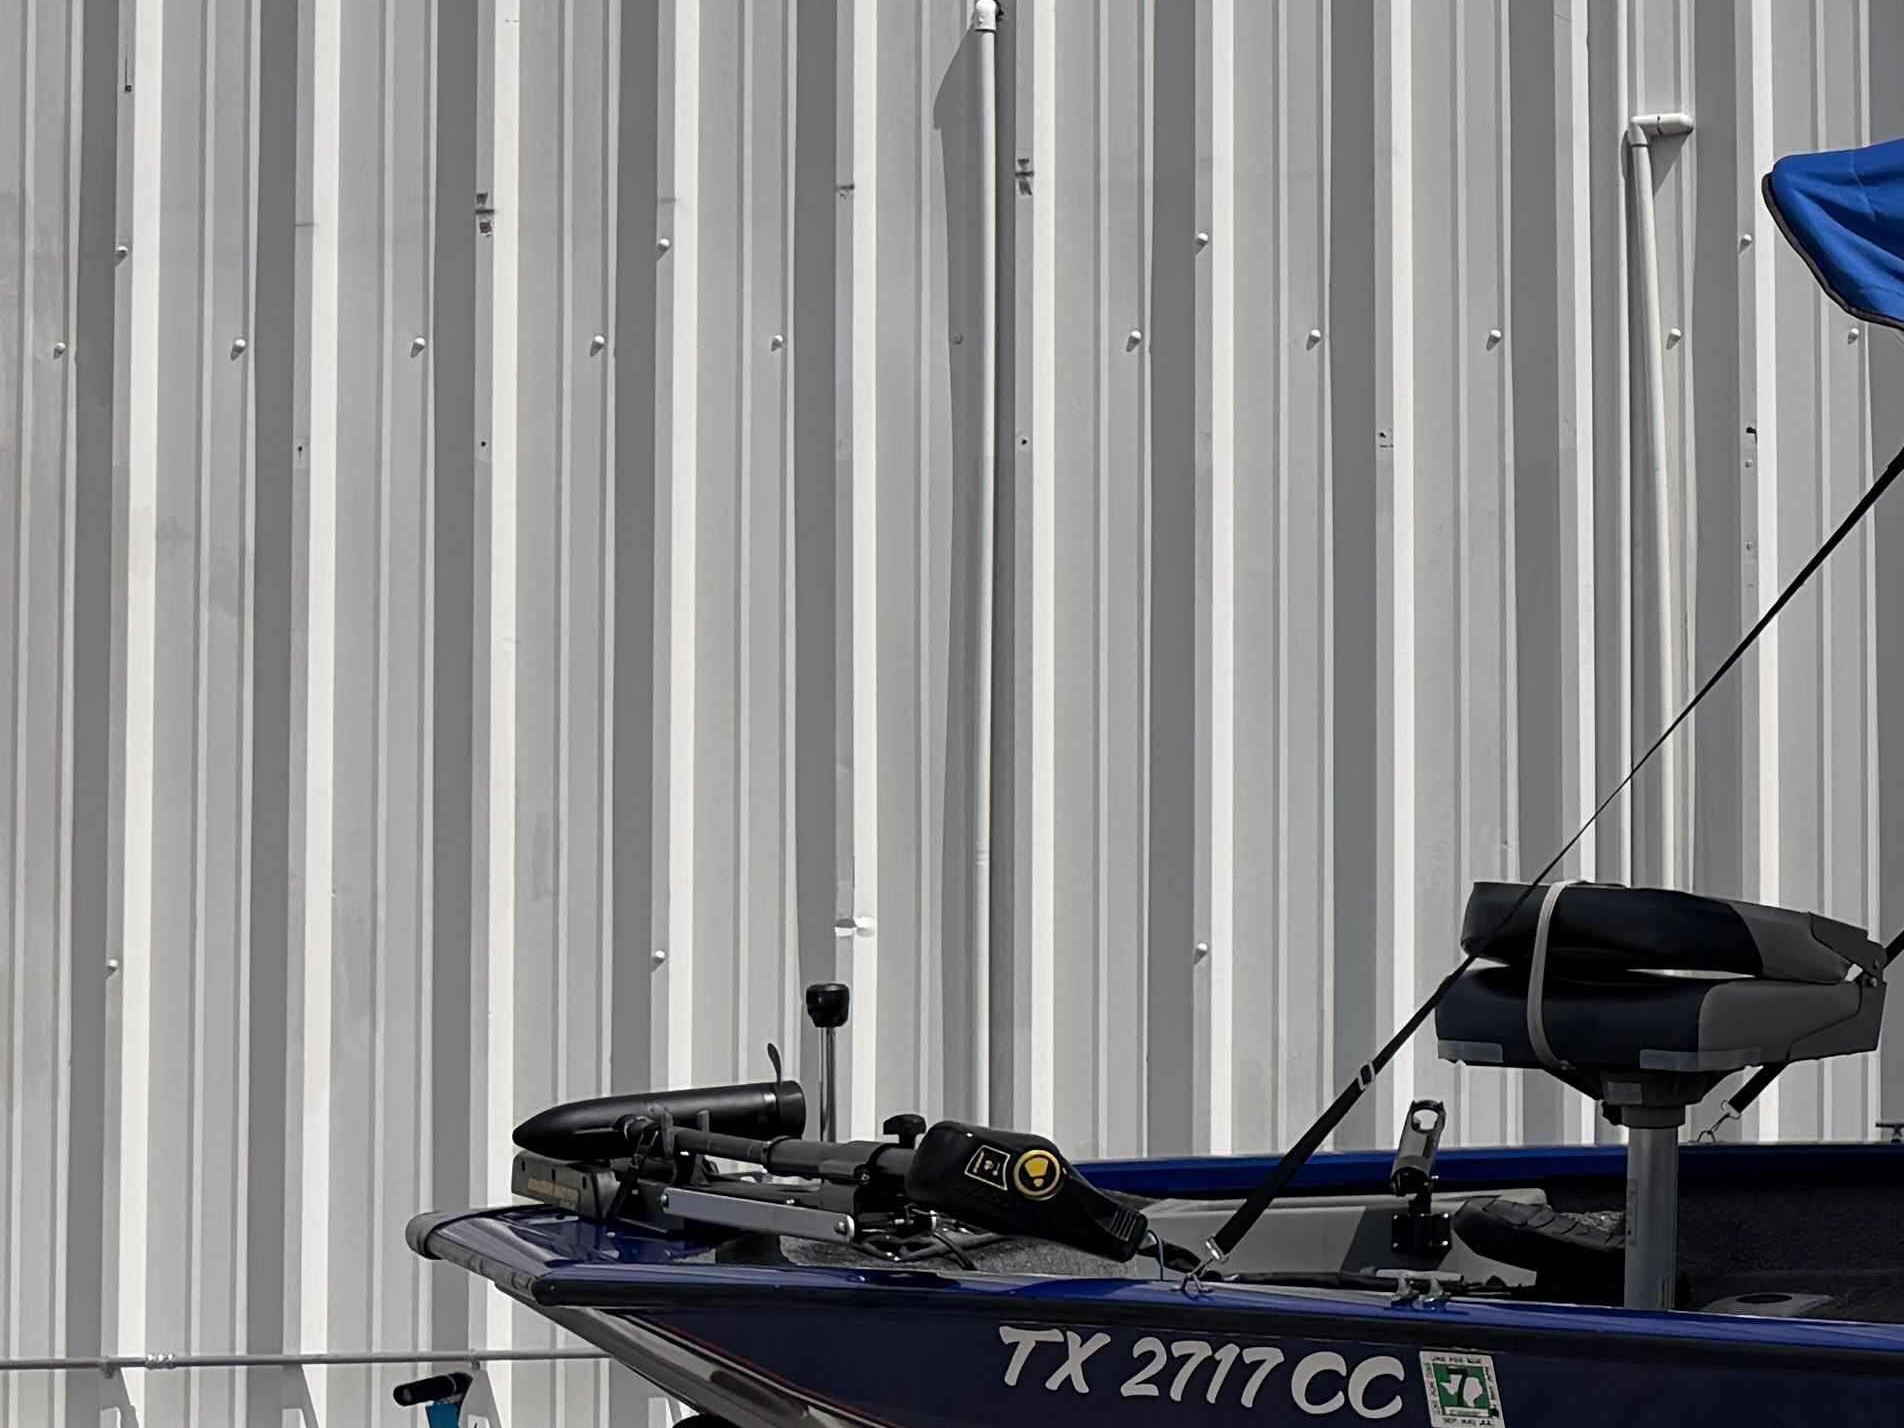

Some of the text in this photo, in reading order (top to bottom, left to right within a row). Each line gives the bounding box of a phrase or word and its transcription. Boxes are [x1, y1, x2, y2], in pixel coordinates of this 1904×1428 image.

[998, 1325, 1112, 1394] TX
[1120, 1336, 1285, 1409] 2717
[1290, 1350, 1405, 1420] CC
